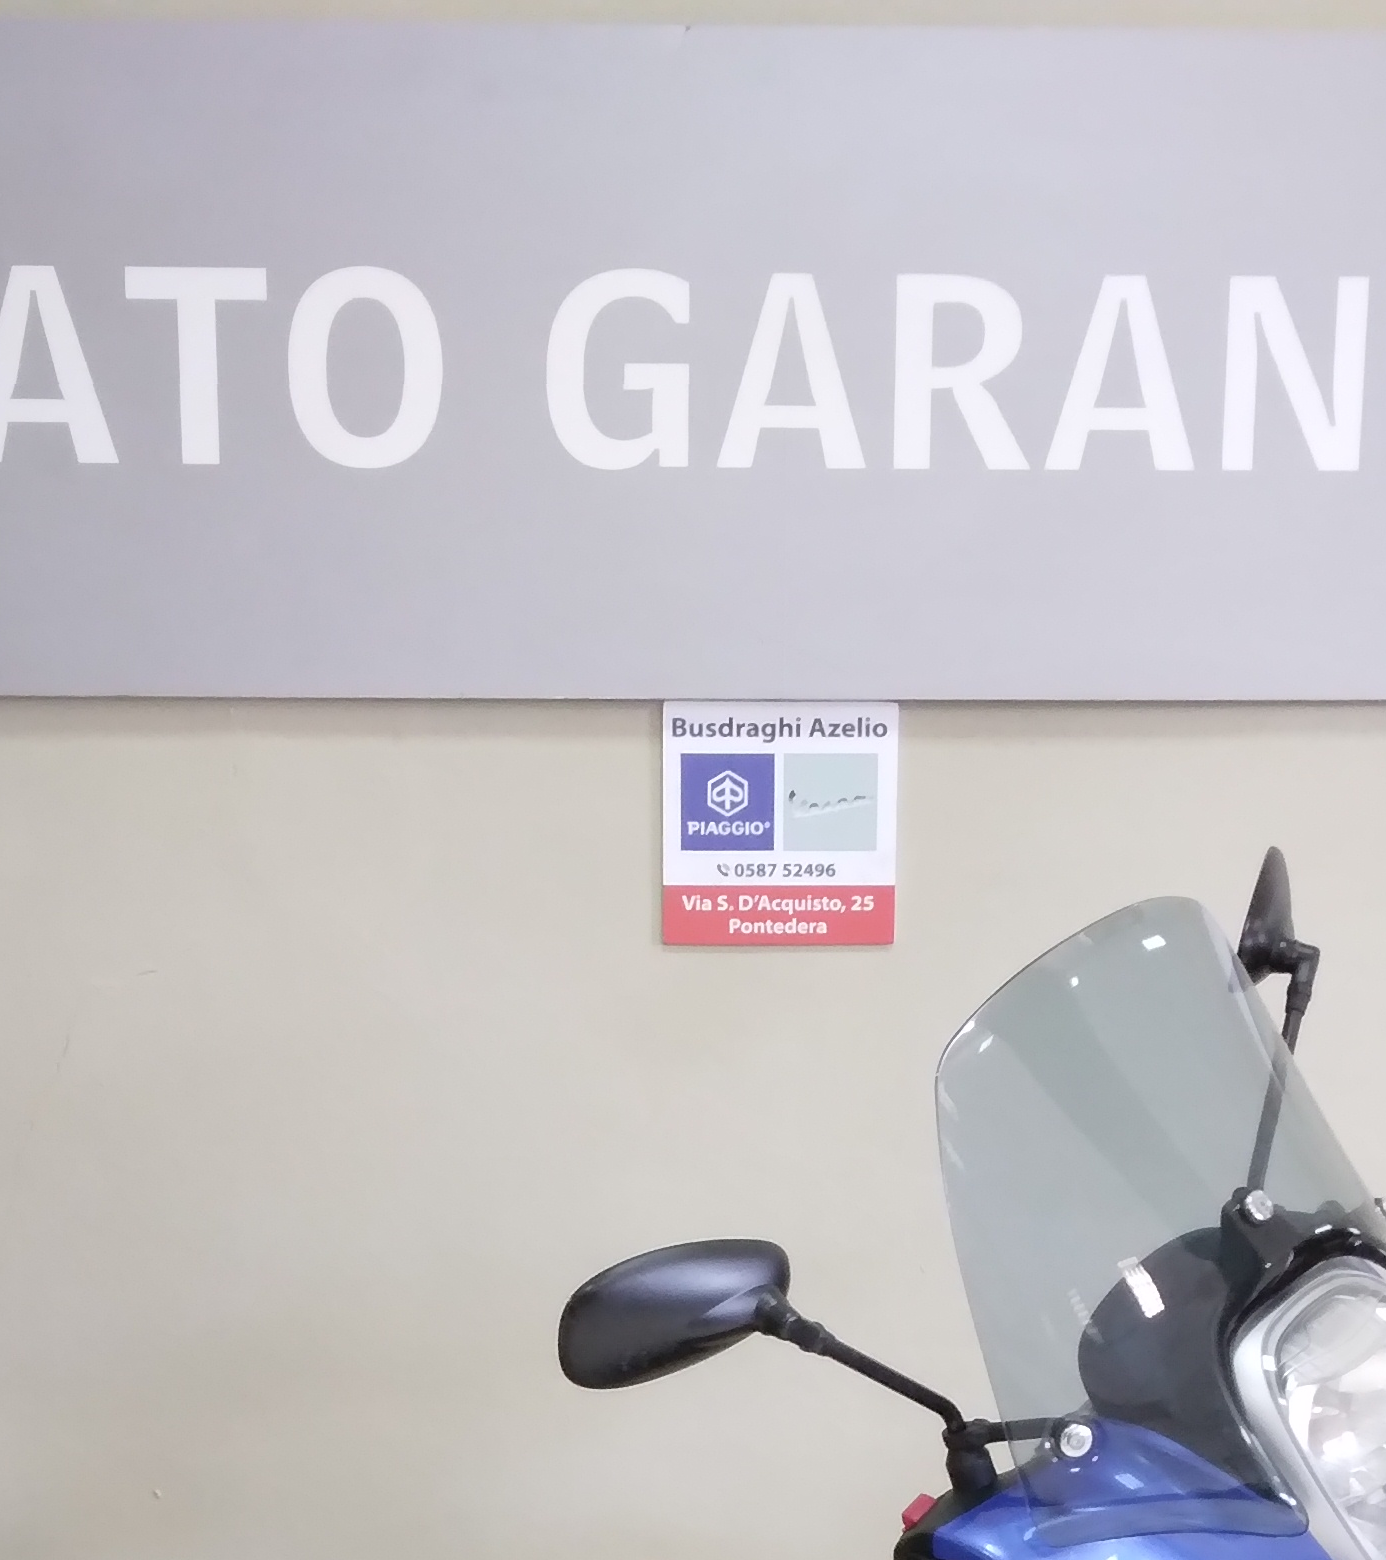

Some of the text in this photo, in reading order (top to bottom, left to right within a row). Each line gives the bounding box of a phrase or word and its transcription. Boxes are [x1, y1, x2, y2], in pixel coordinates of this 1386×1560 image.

[671, 716, 888, 744] Busdraghi Azelio
[734, 863, 836, 878] 0587 52496
[681, 894, 713, 912] Via
[717, 894, 734, 912] S.
[850, 895, 875, 912] 25
[728, 917, 828, 935] Pontedera
